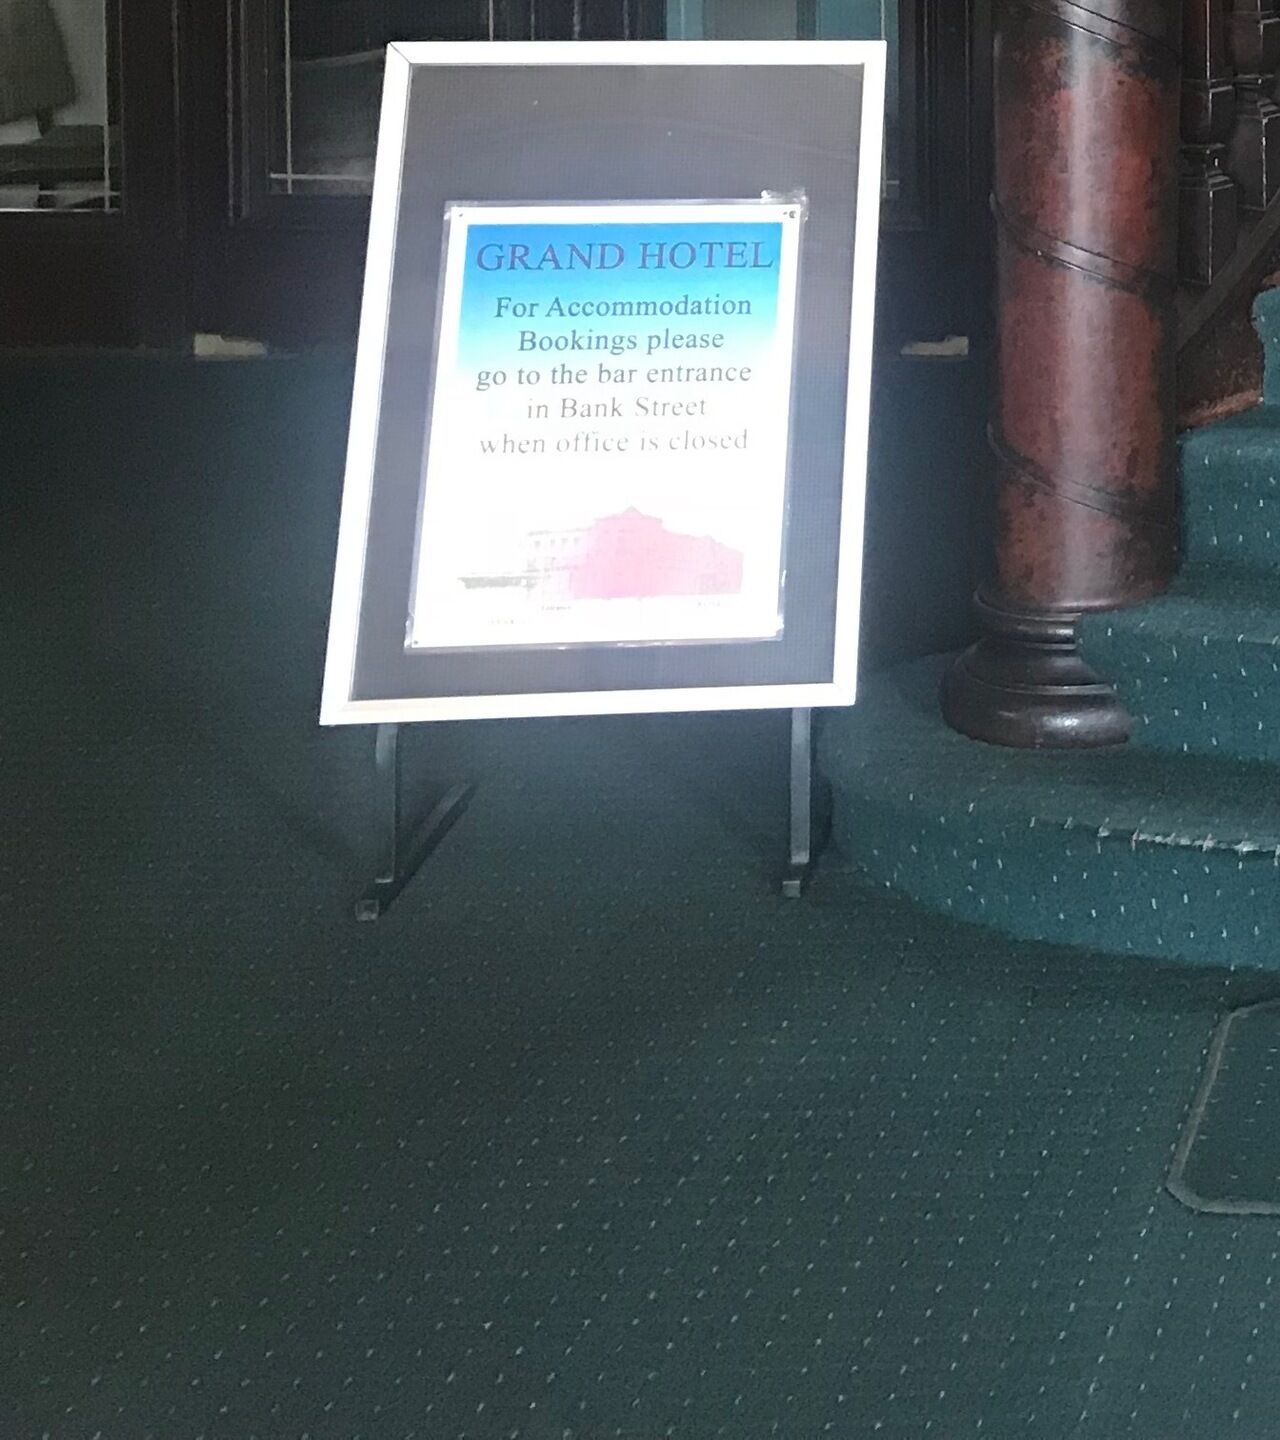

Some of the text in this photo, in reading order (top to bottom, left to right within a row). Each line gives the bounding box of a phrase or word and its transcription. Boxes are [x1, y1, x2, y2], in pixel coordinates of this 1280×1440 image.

[476, 241, 773, 271] GRAND HOTEL
[494, 293, 752, 317] For Accommodation
[518, 328, 725, 355] Bookings please
[476, 363, 752, 391] go to the bar entrance
[528, 396, 706, 418] in Bank Street
[480, 428, 747, 453] when office is closed
